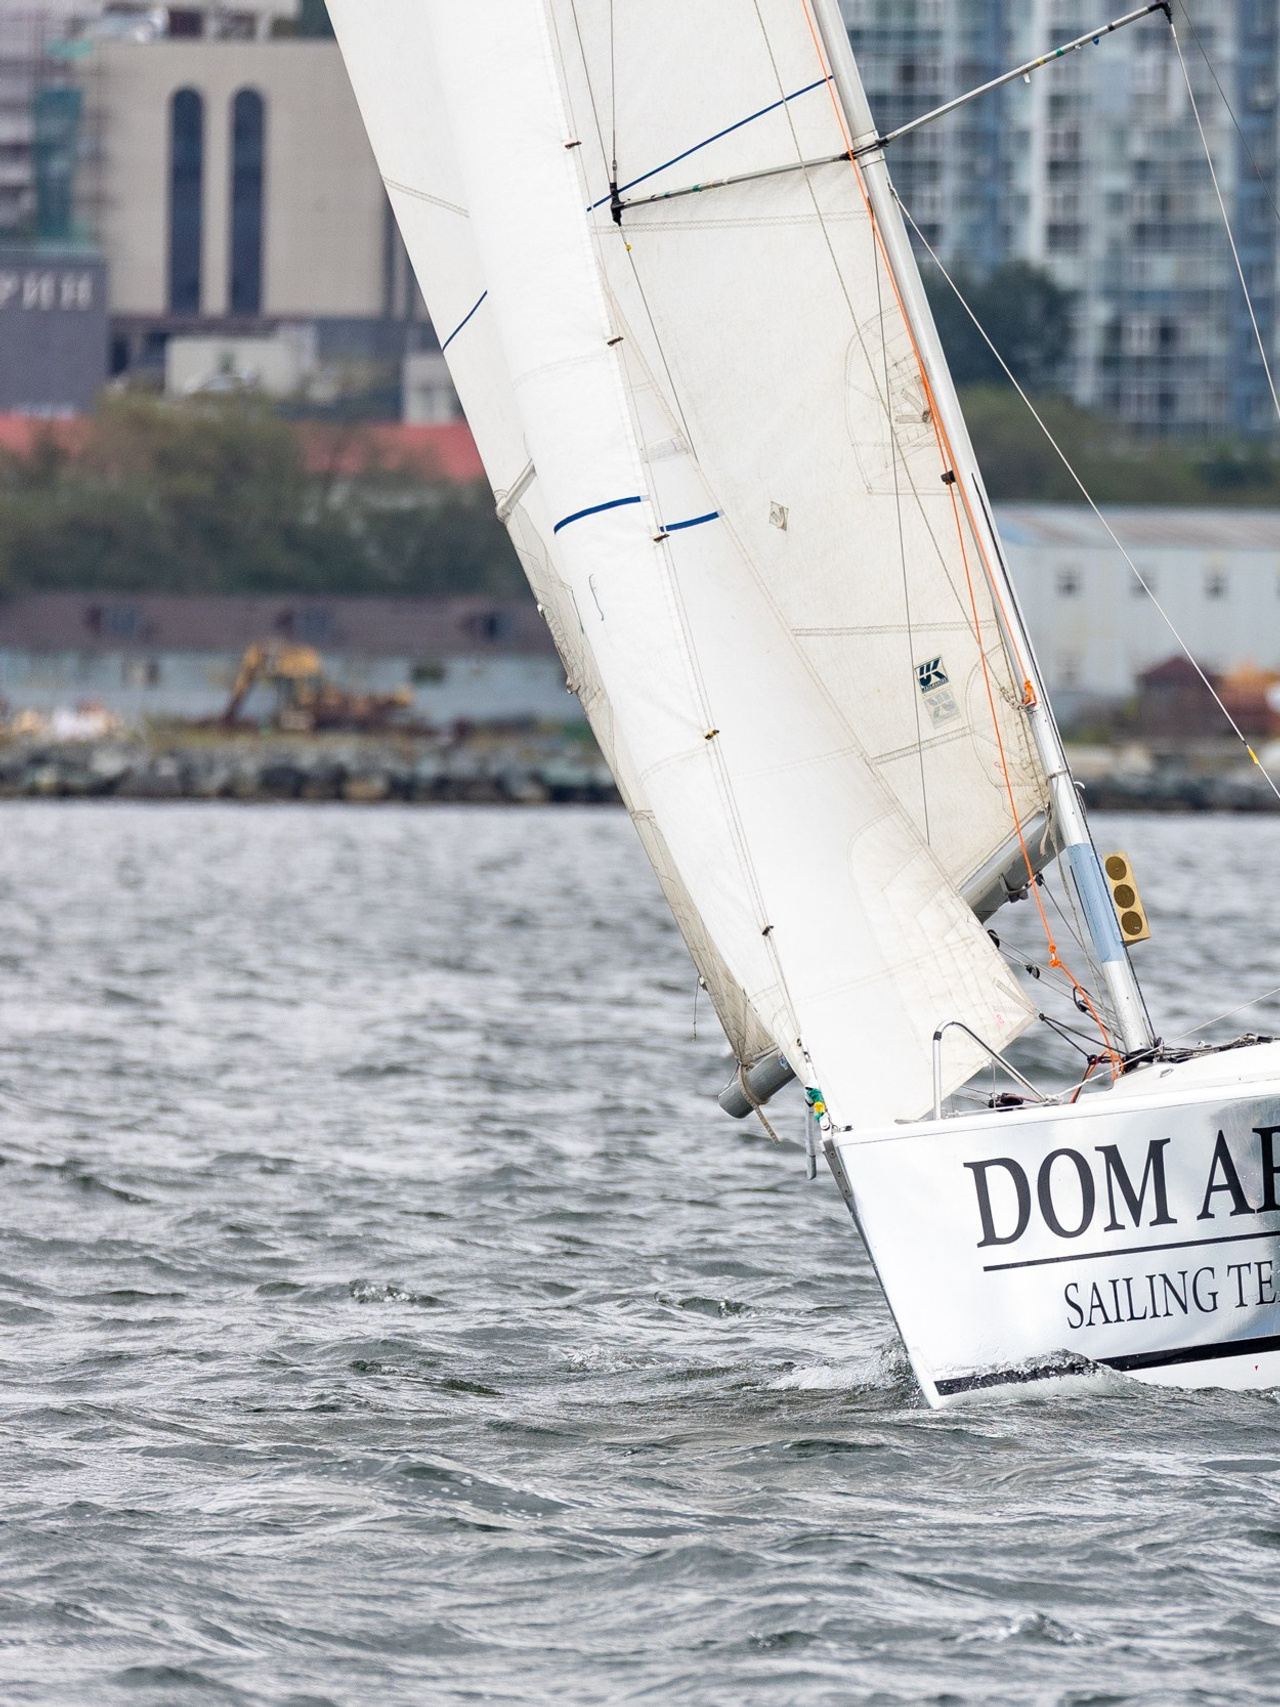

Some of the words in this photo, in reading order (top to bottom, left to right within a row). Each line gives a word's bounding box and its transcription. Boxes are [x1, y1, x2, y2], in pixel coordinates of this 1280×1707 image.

[919, 658, 948, 687] UK
[963, 1137, 1178, 1248] DOM
[1064, 1266, 1219, 1329] SAILING
